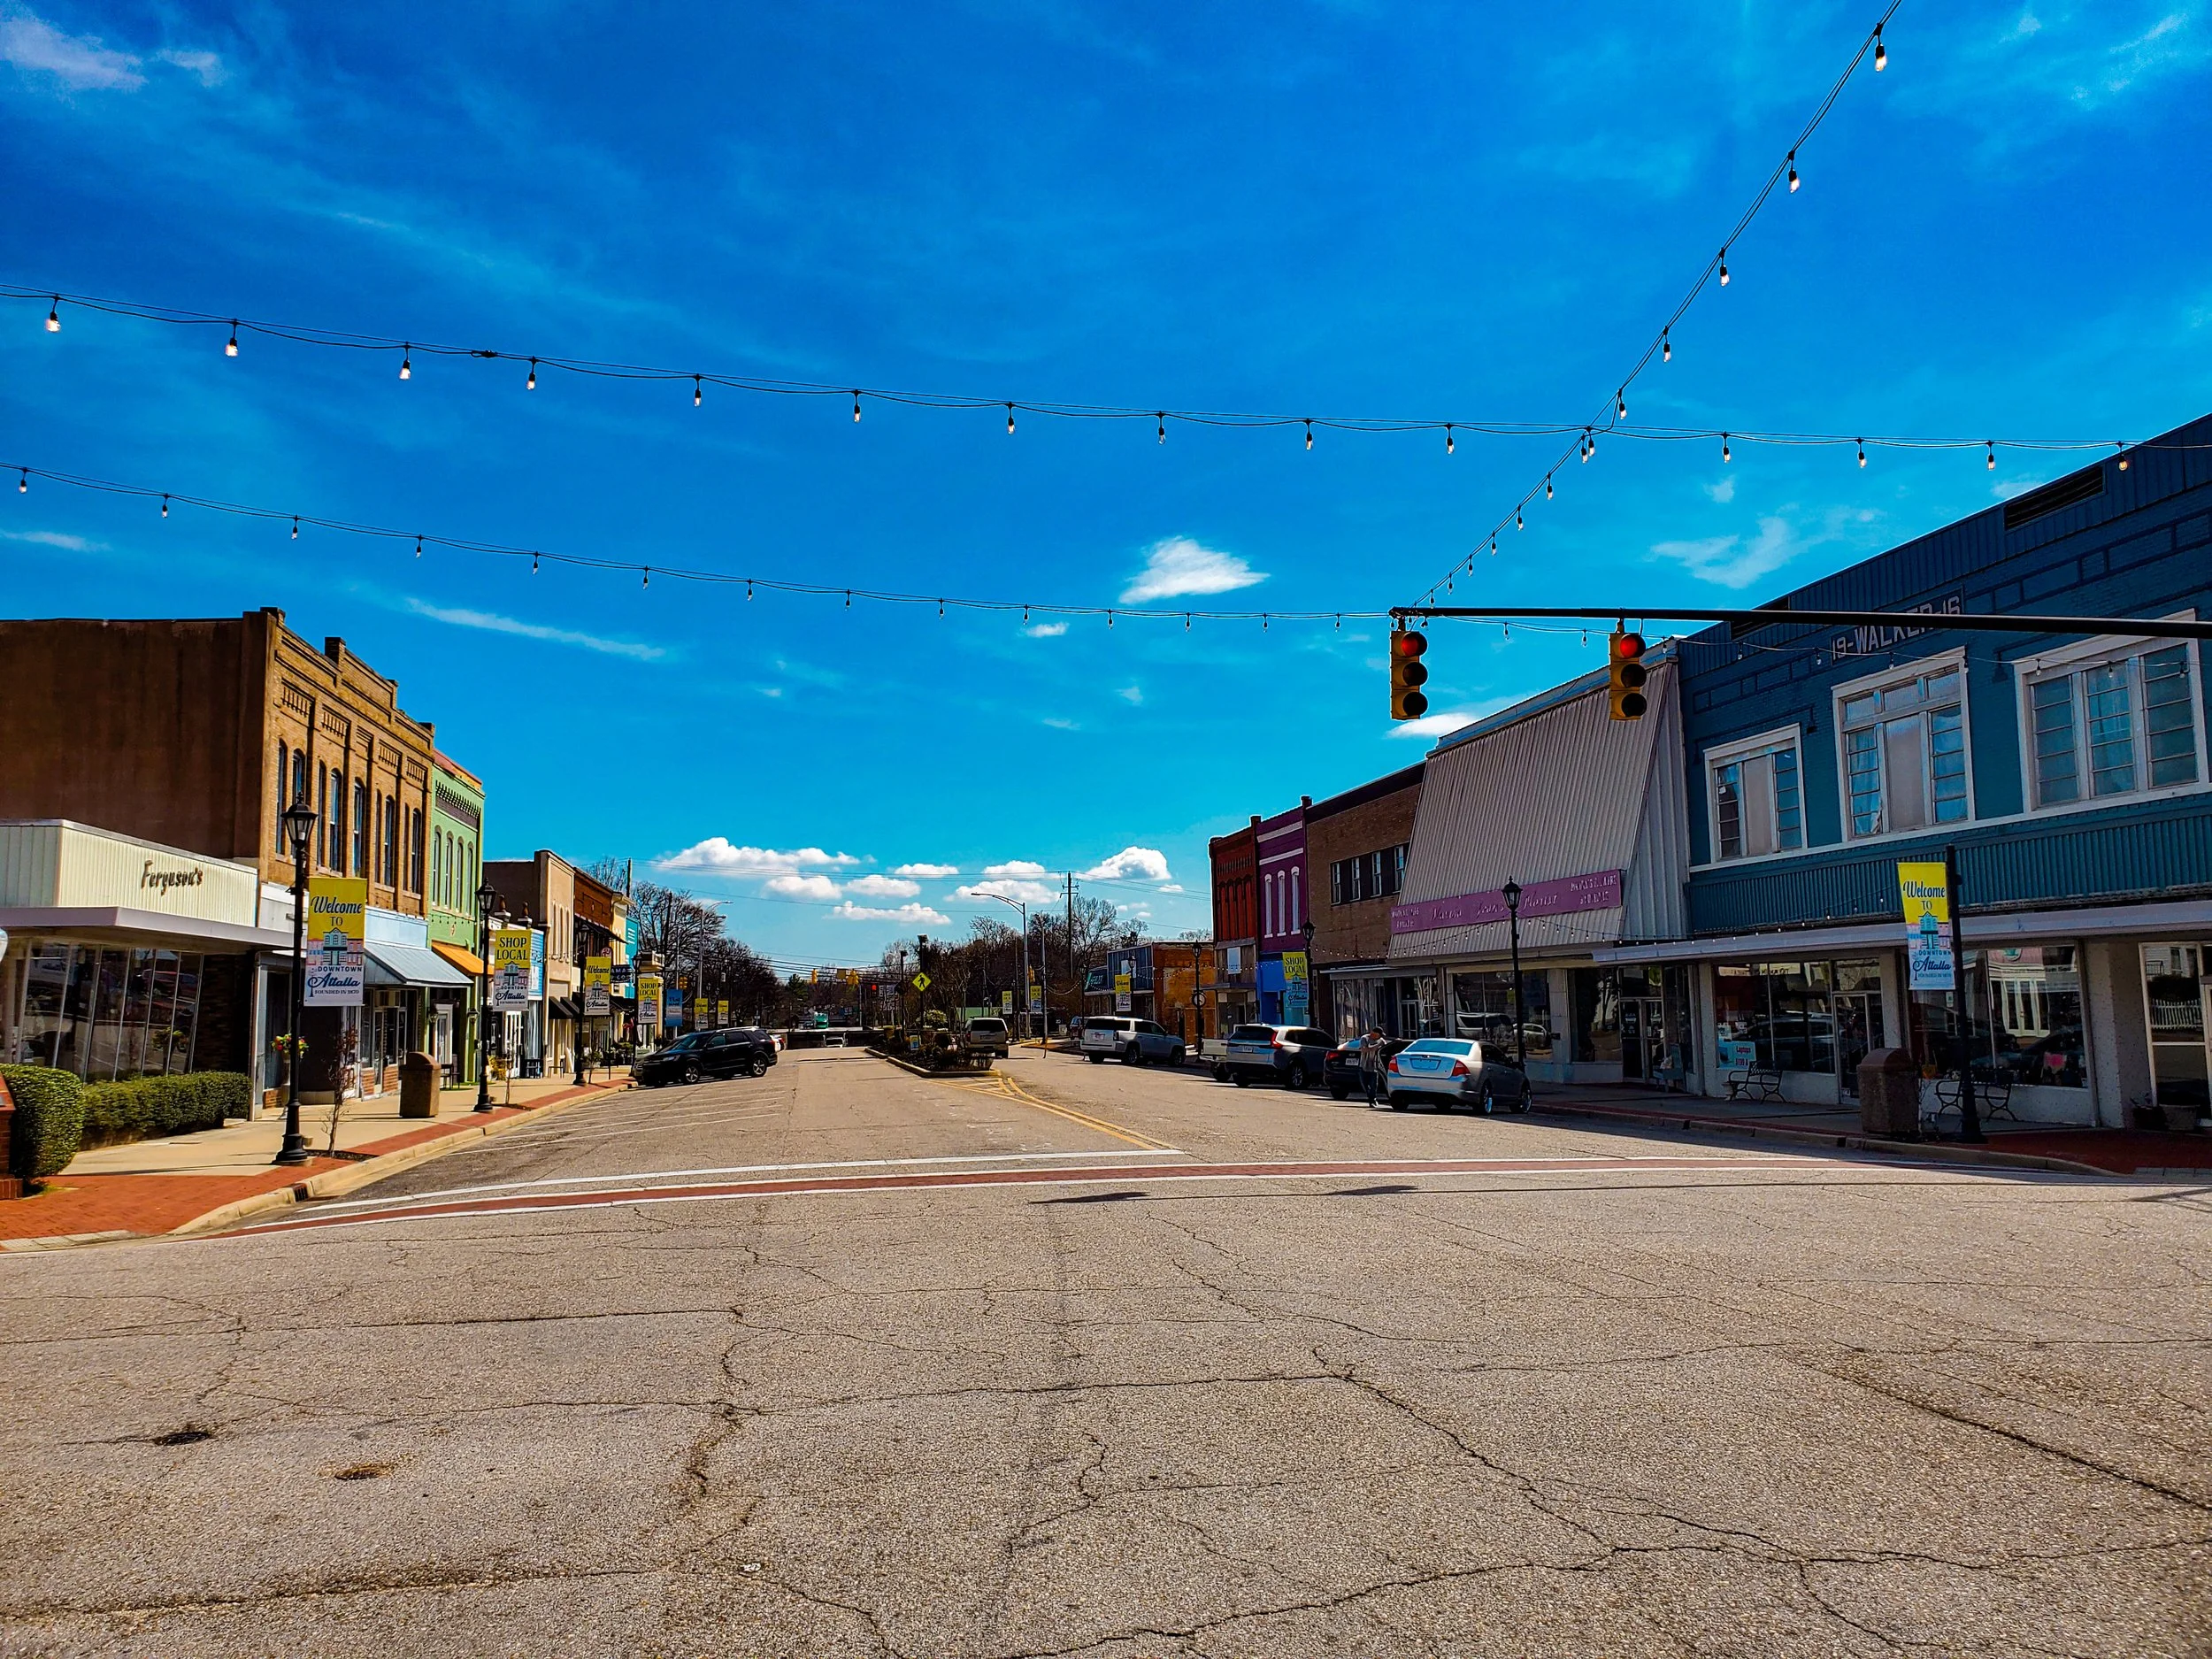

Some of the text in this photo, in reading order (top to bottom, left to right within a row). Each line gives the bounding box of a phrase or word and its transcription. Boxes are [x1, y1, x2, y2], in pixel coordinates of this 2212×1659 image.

[141, 859, 204, 896] Ferguson's
[1902, 880, 1946, 898] Welcome
[311, 895, 363, 914] Welcome
[1921, 900, 1932, 910] TO
[329, 916, 343, 926] TO
[499, 937, 527, 948] SHOP
[496, 949, 528, 960] LOCAL
[1285, 956, 1304, 965] SHOP
[1912, 955, 1951, 972] Attalla
[587, 964, 610, 974] Welcome
[307, 972, 361, 988] Attalla
[495, 990, 526, 1001] Attalla
